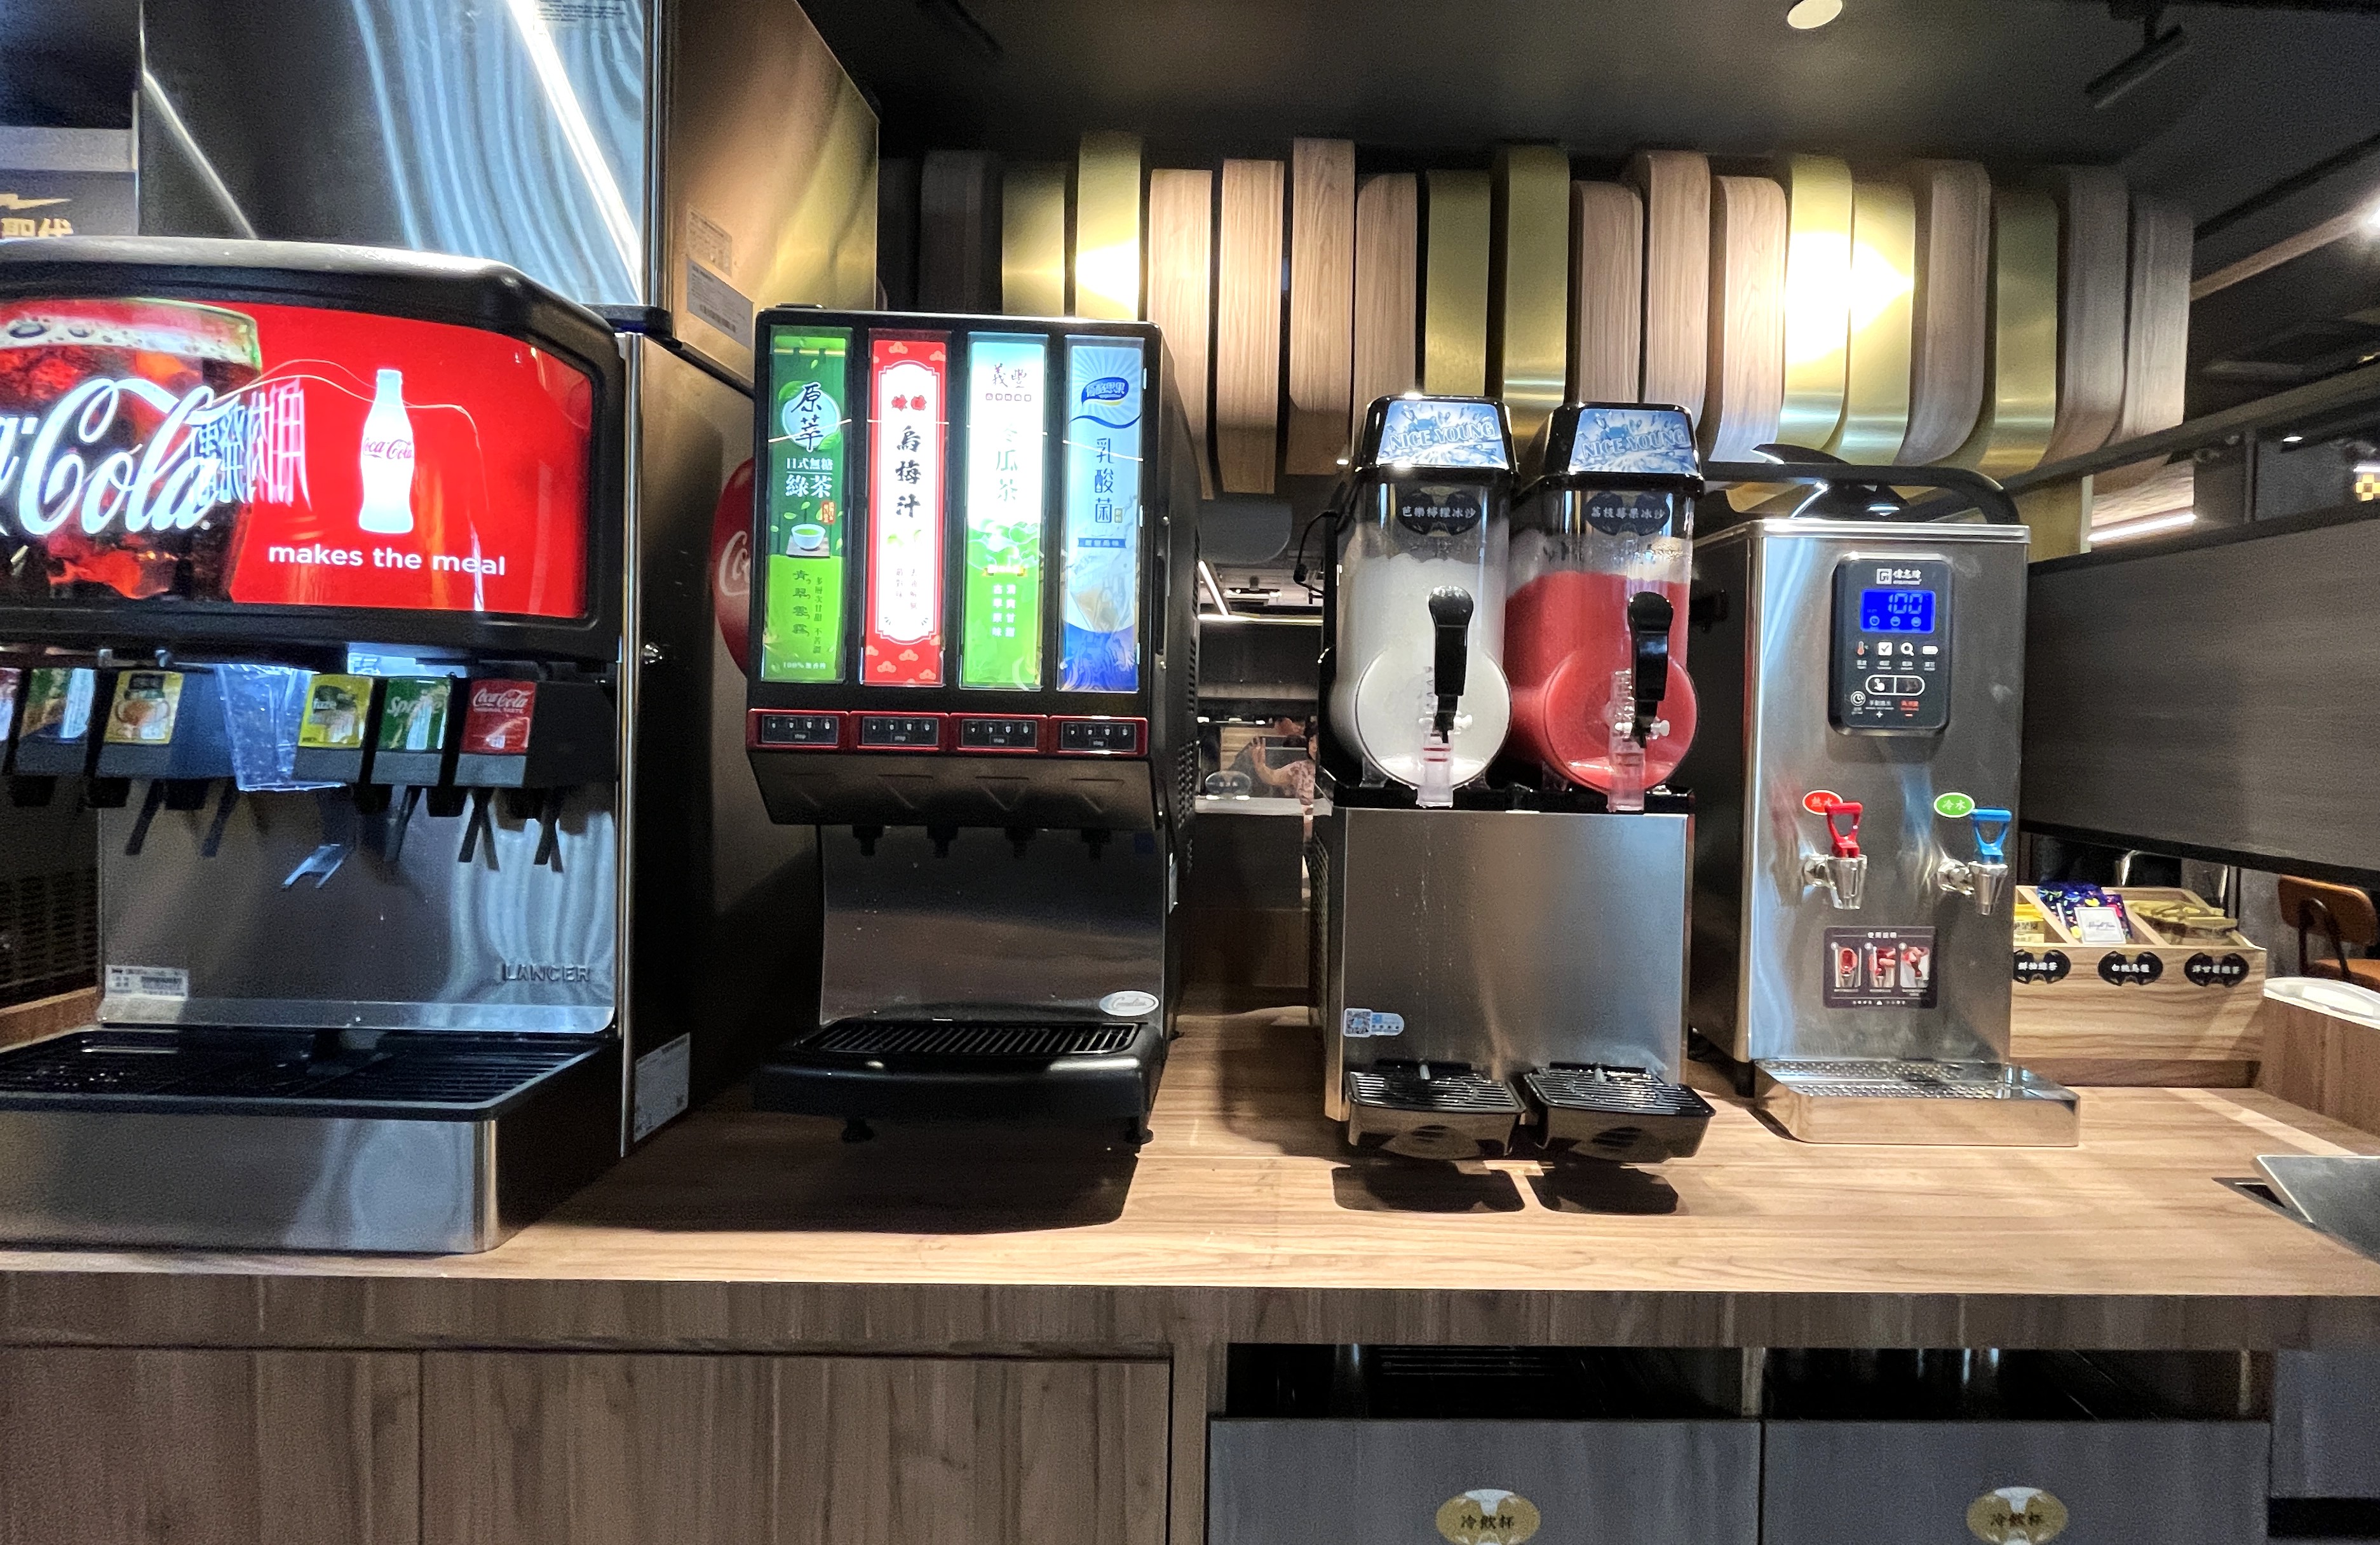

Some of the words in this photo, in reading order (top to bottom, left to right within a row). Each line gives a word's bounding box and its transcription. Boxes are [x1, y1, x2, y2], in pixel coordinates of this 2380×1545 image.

[1389, 429, 1433, 451] NICE
[1435, 422, 1496, 445] YOUNG
[1581, 437, 1625, 459] NICE
[1626, 428, 1690, 451] YOUNG
[787, 457, 834, 471] 日式無糖
[895, 425, 921, 518] 烏梅汁
[785, 474, 833, 498] 綠茶
[1095, 437, 1114, 523] 乳酸菌
[269, 544, 363, 566] makes
[373, 547, 422, 569] the
[433, 553, 505, 576] meal
[1888, 593, 1923, 614] 100
[1942, 800, 1966, 810] 冷水
[503, 964, 590, 982] LANCER
